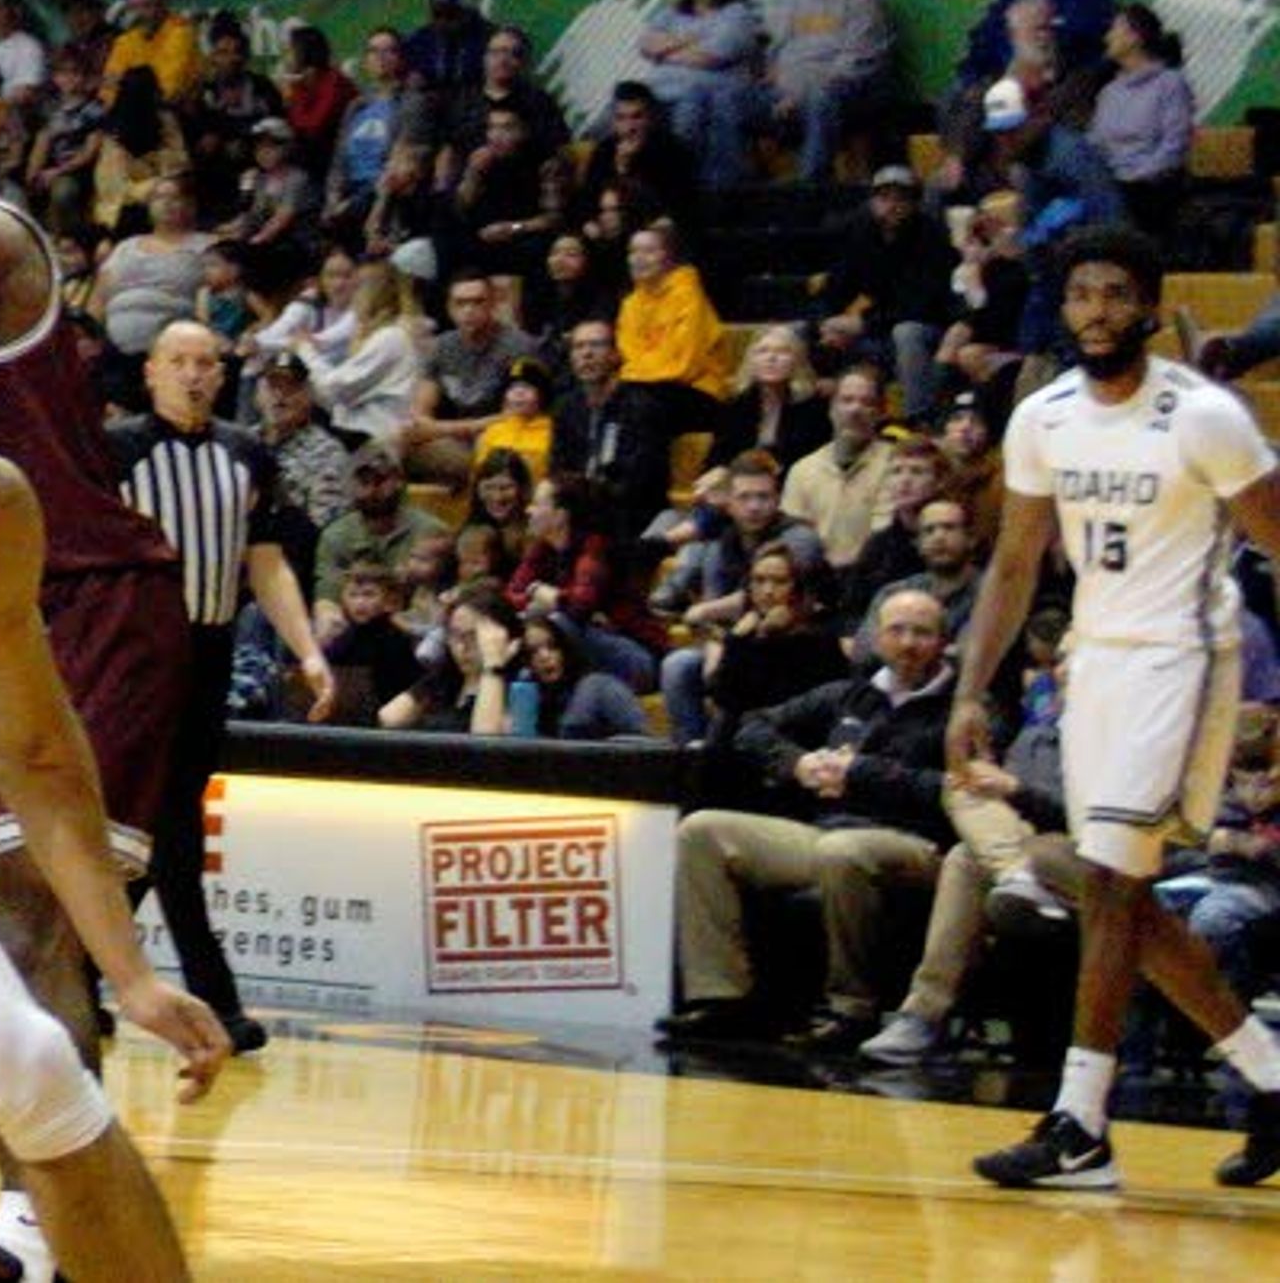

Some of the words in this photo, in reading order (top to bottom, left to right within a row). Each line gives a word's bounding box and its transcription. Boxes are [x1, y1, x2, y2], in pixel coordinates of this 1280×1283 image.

[1082, 518, 1130, 573] 15
[432, 841, 608, 882] PROJECT
[209, 881, 282, 917] hes,
[300, 894, 373, 927] gum
[434, 895, 610, 950] FILTER
